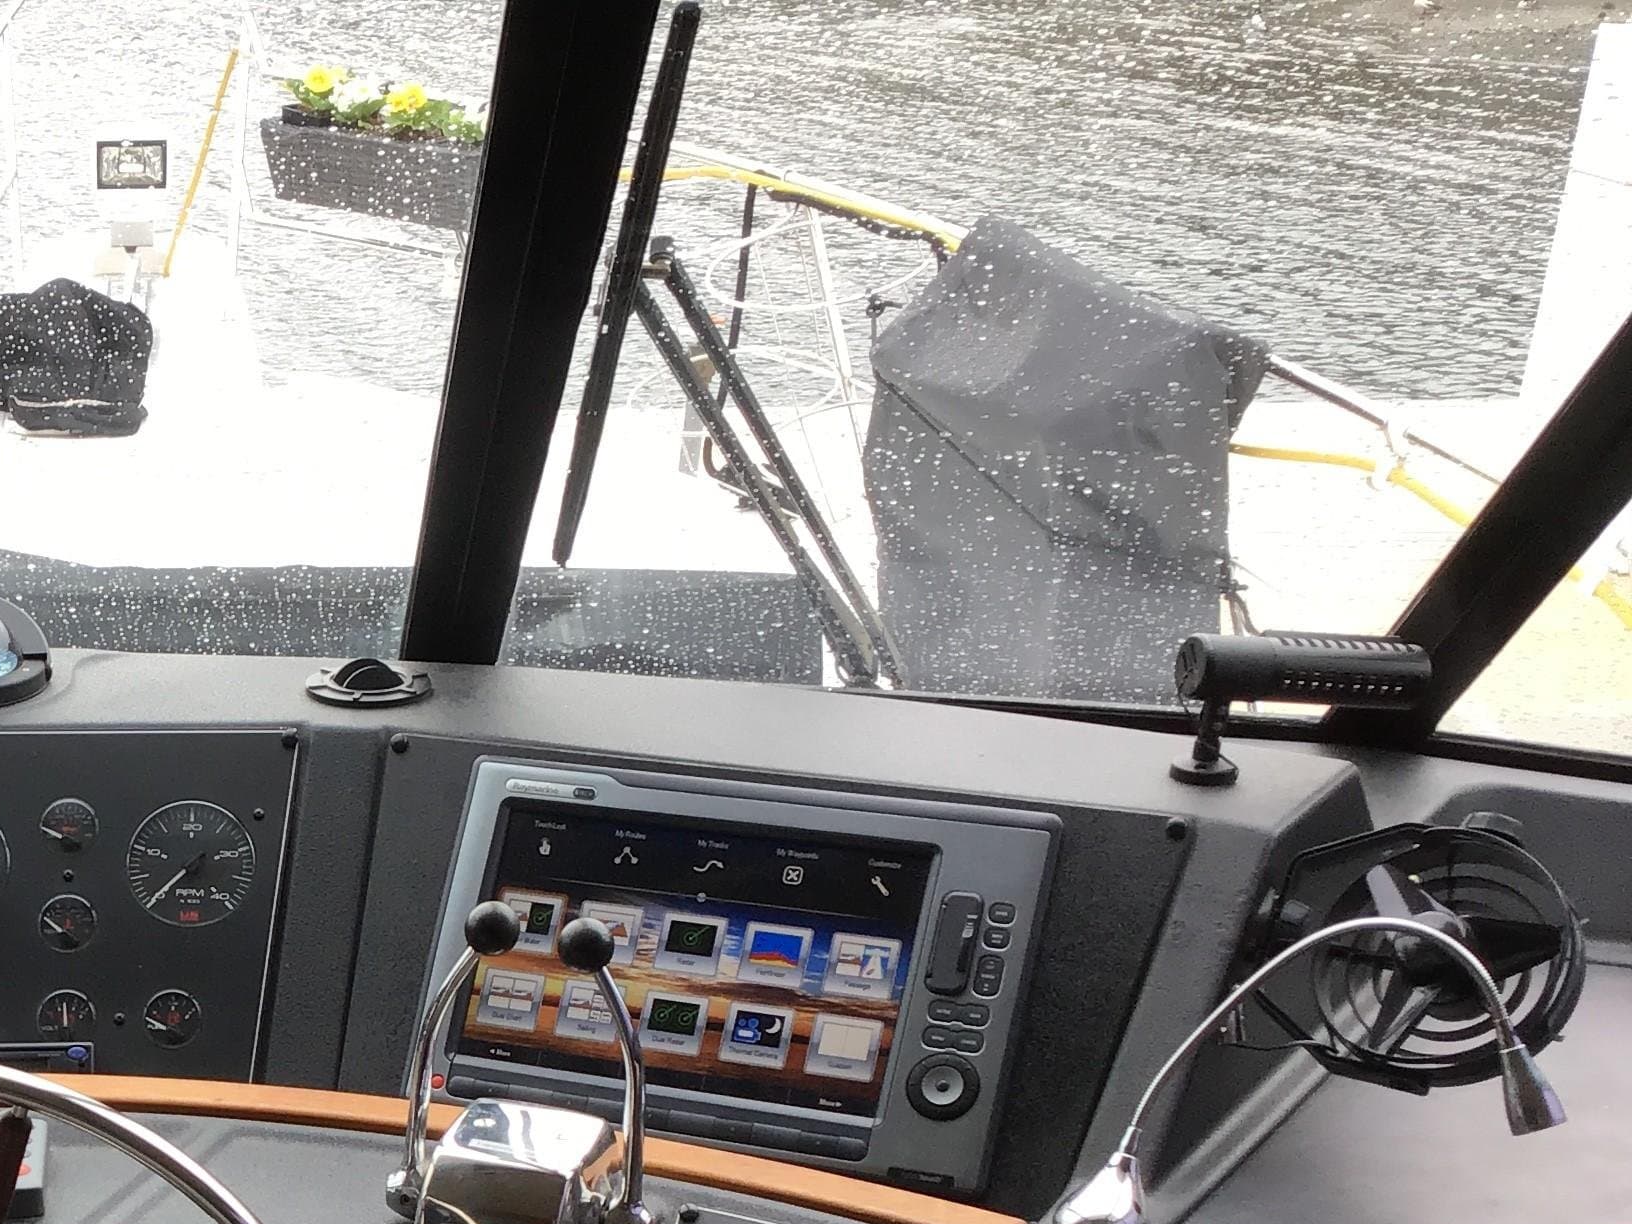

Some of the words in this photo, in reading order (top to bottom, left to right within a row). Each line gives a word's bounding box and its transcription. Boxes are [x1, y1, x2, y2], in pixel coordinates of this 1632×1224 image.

[182, 823, 203, 831] 20
[146, 848, 161, 856] 10
[218, 850, 239, 858] 30
[175, 889, 205, 897] RPM
